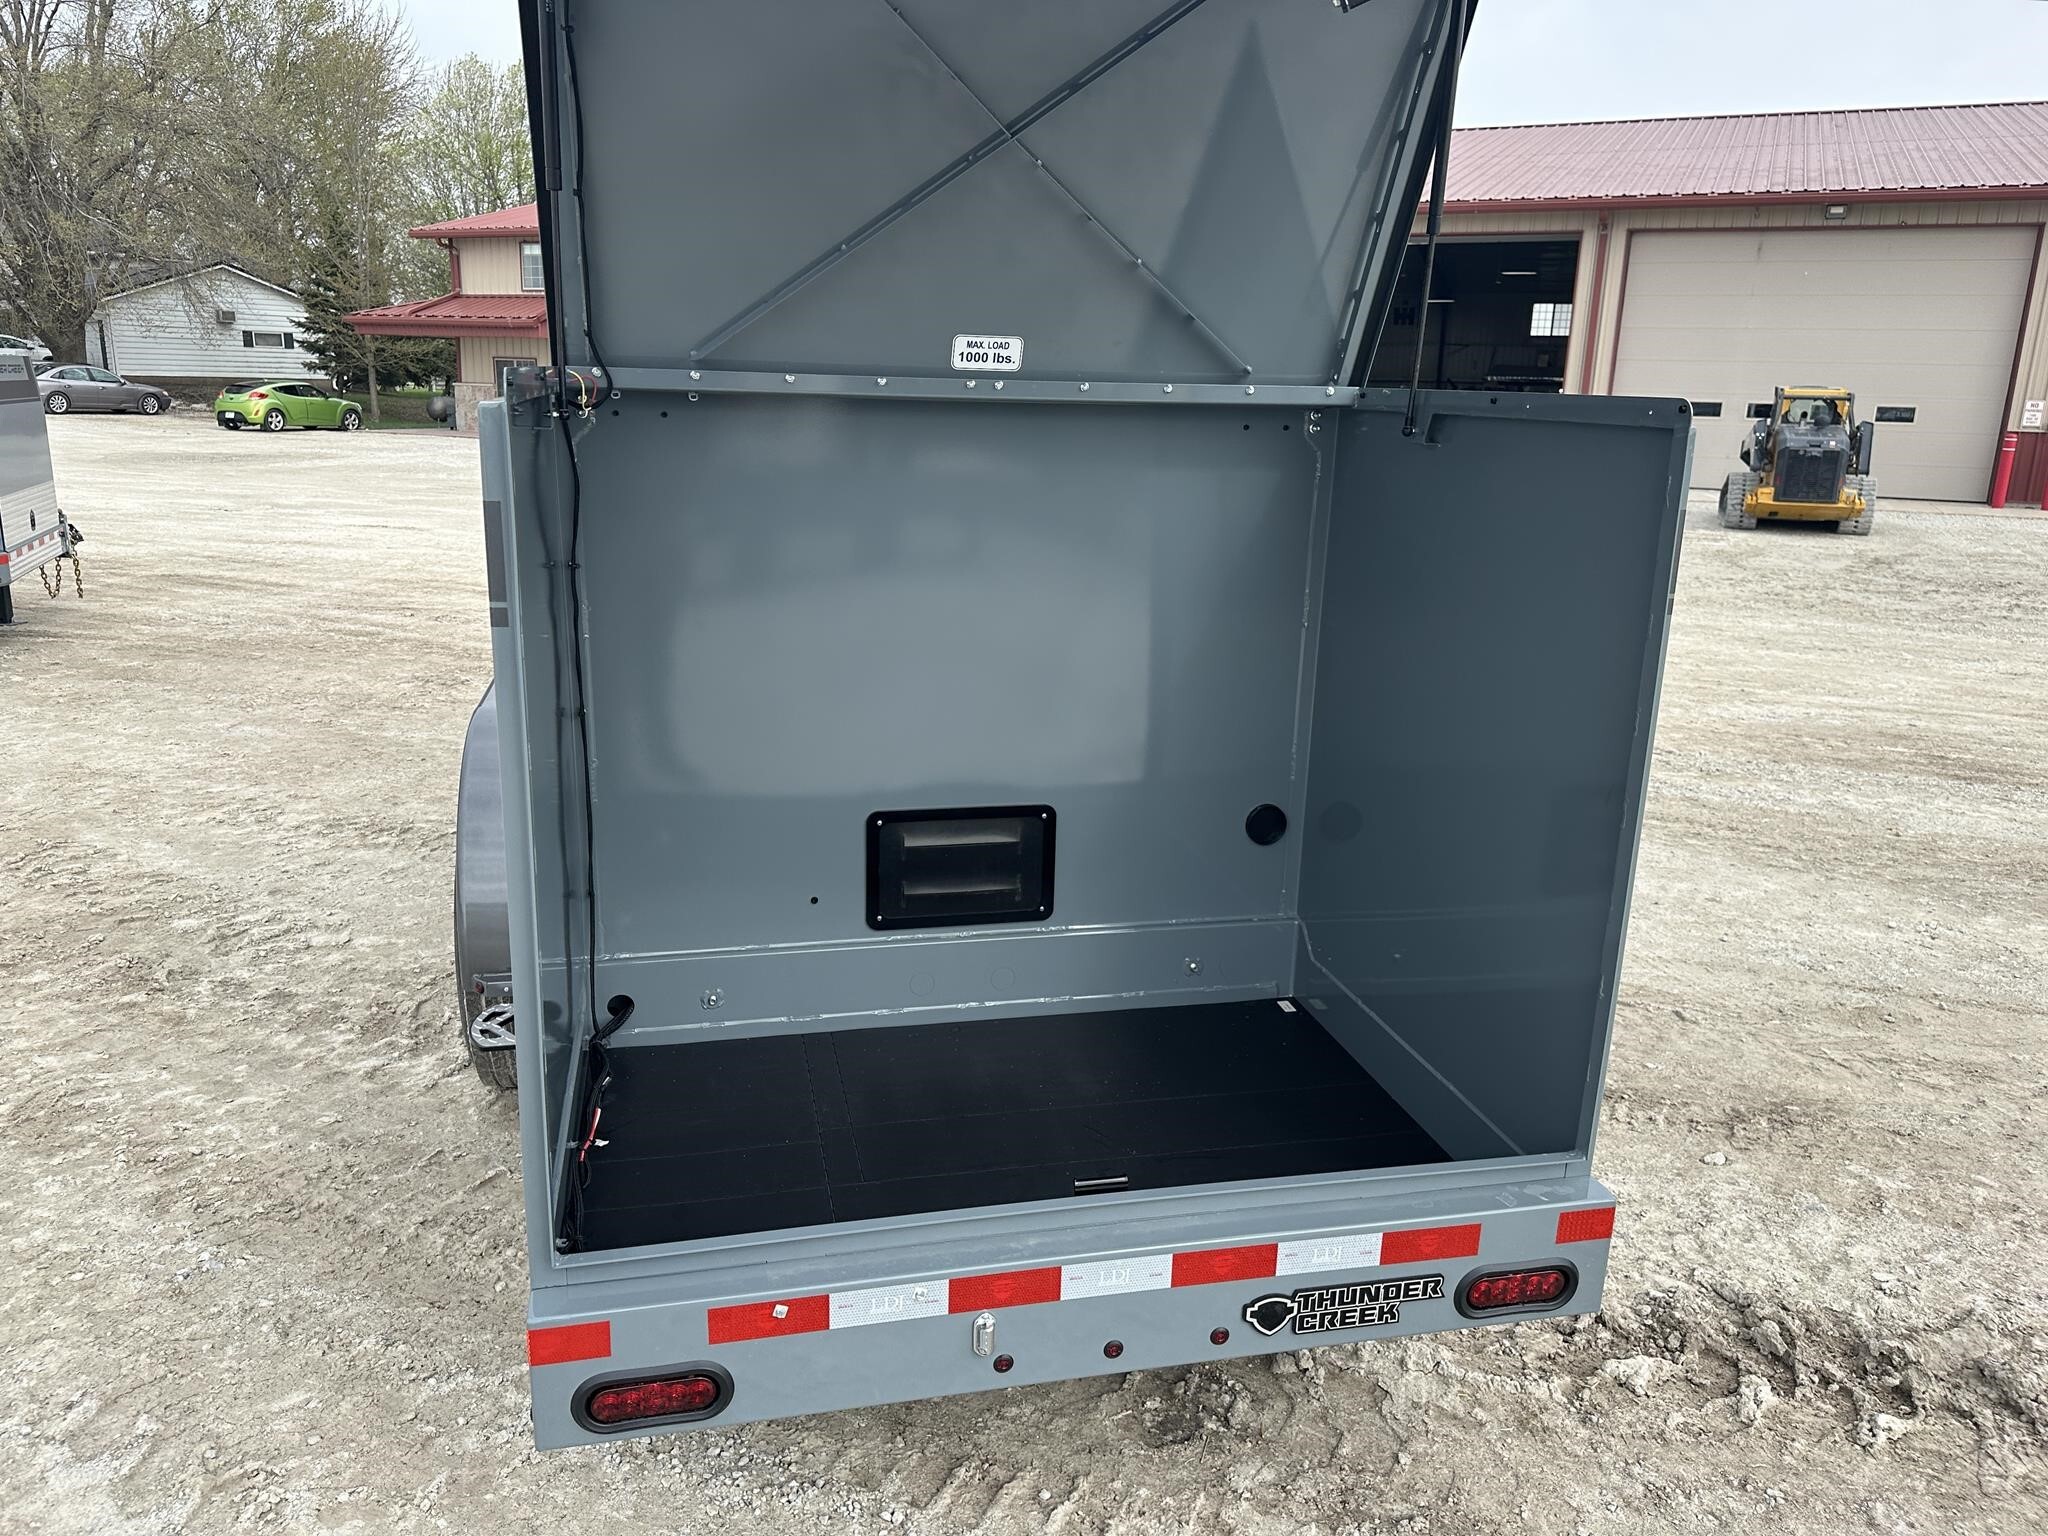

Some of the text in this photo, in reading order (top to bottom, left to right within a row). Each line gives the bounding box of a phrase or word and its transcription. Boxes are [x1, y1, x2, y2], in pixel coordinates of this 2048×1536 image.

[966, 340, 1010, 350] MAX. LOAD
[958, 351, 1016, 364] 1000 lbs.
[1296, 1276, 1443, 1313] THUNDER
[1296, 1302, 1400, 1334] CREEK
